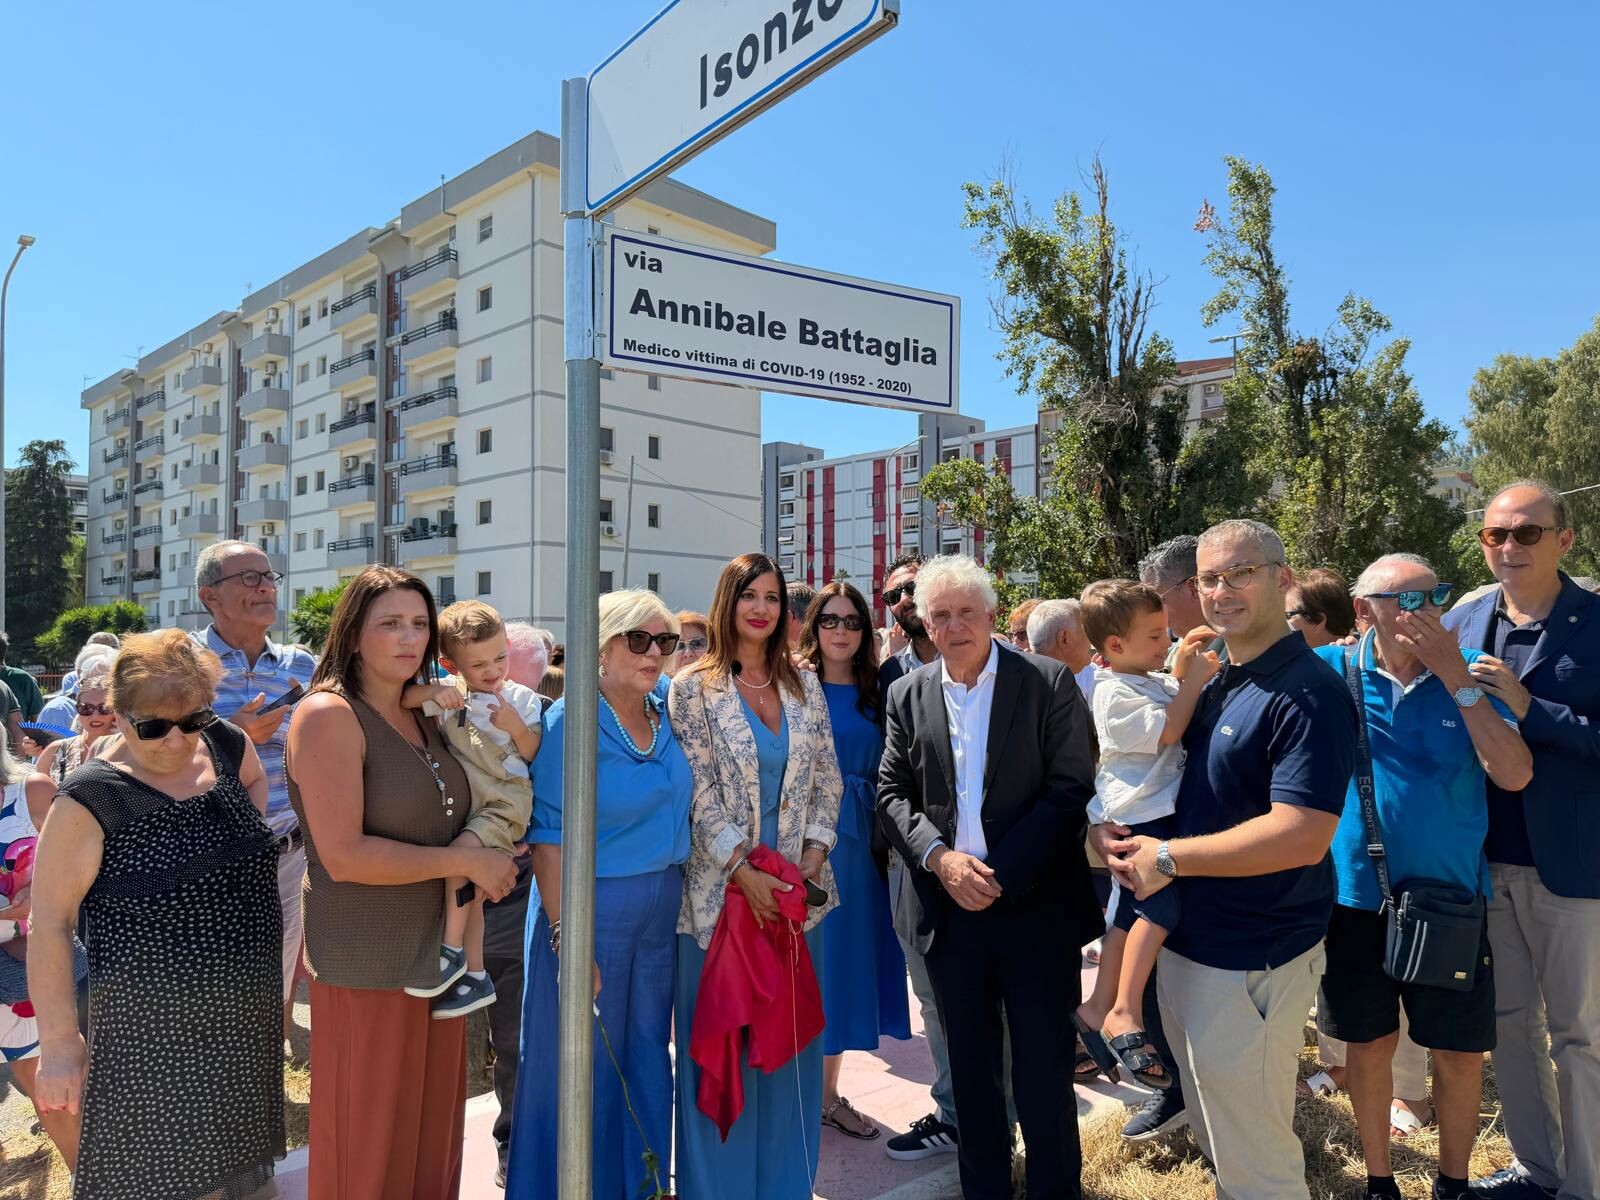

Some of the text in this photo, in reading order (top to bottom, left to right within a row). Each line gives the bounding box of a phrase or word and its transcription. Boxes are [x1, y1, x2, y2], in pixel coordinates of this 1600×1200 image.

[623, 250, 663, 274] via
[628, 287, 937, 367] Annibale Battaglia
[623, 338, 681, 359] Medico
[685, 351, 738, 368] vittima
[742, 358, 755, 371] di
[759, 360, 825, 381] COVID-19
[829, 370, 866, 387] (1952
[876, 378, 912, 396] 2020)
